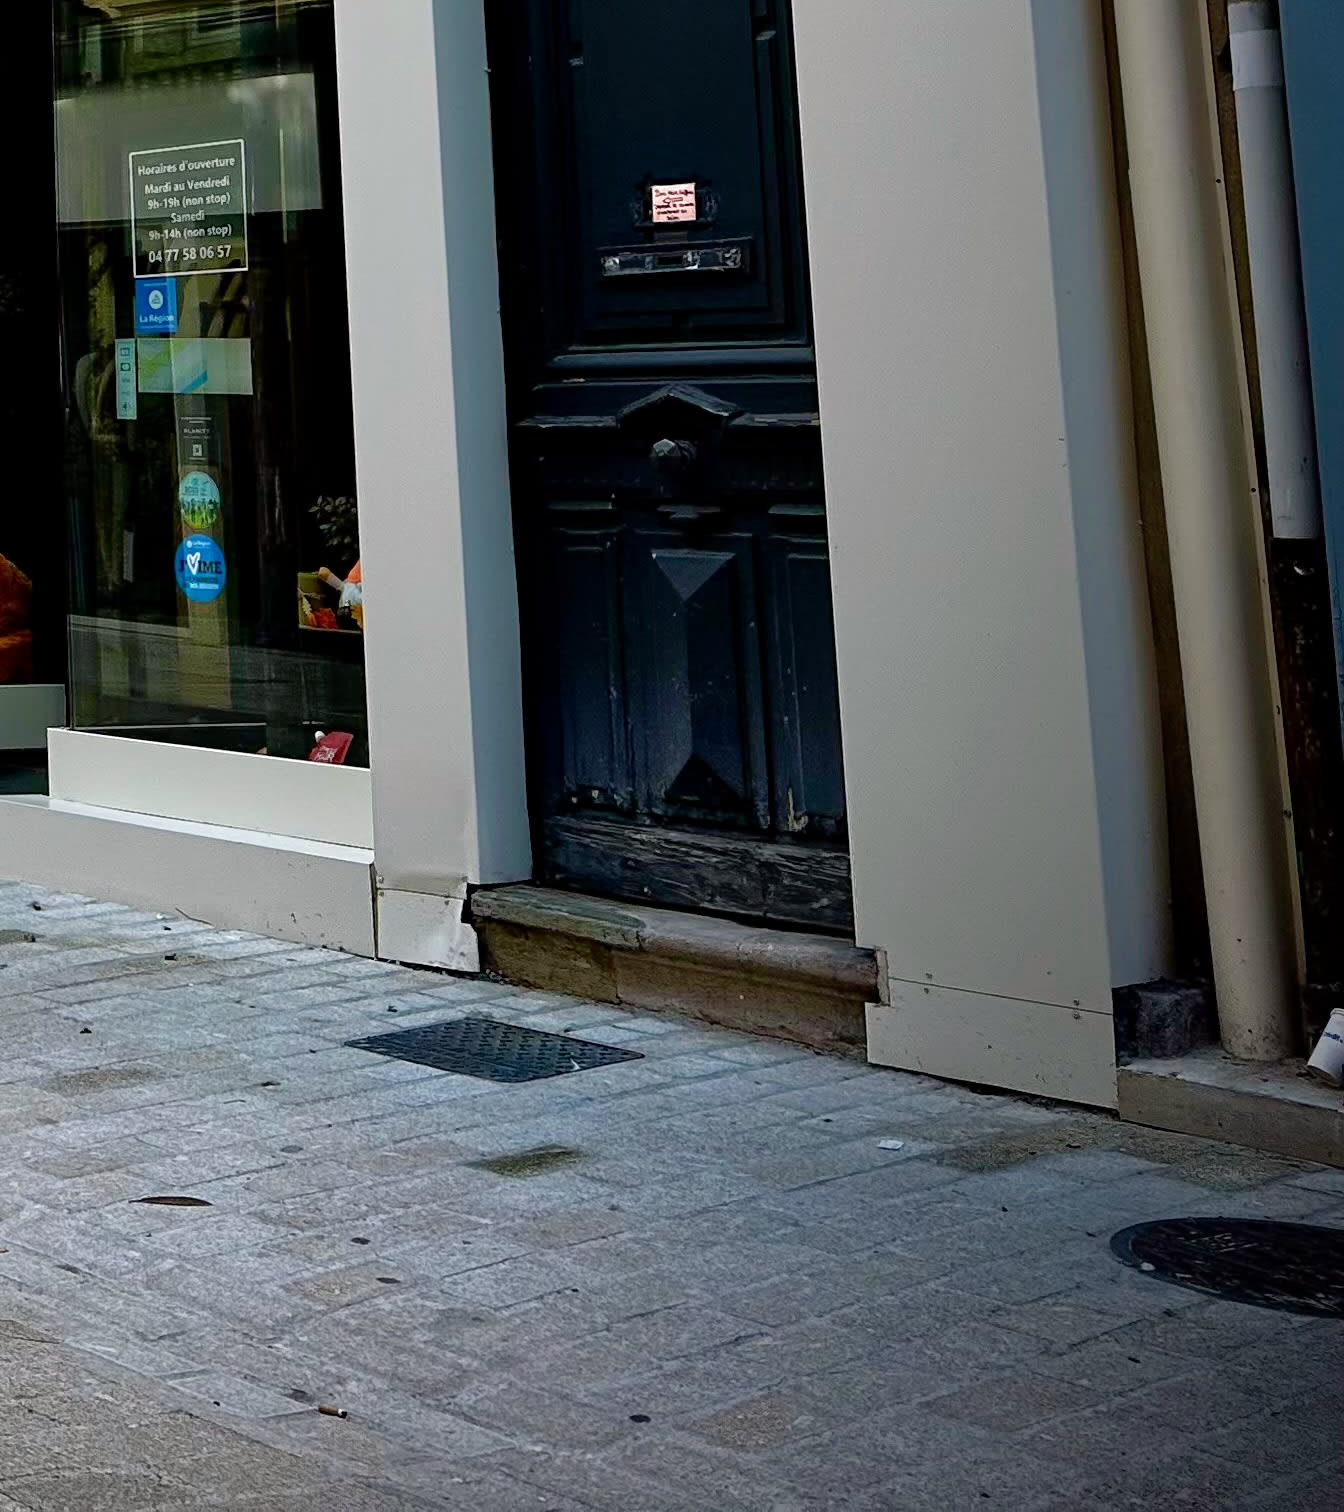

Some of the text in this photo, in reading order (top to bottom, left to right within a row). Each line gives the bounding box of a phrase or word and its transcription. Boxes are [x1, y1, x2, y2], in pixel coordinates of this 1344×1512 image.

[137, 157, 235, 176] Horaires d'ouverture
[144, 175, 230, 194] Mardi au Vendredi
[147, 192, 231, 209] 9h-19h (non stop)
[171, 210, 205, 223] Samedi
[148, 224, 232, 240] 9h-14h (non stop)
[148, 245, 232, 263] 04 77 58 06 57
[139, 315, 151, 323] La
